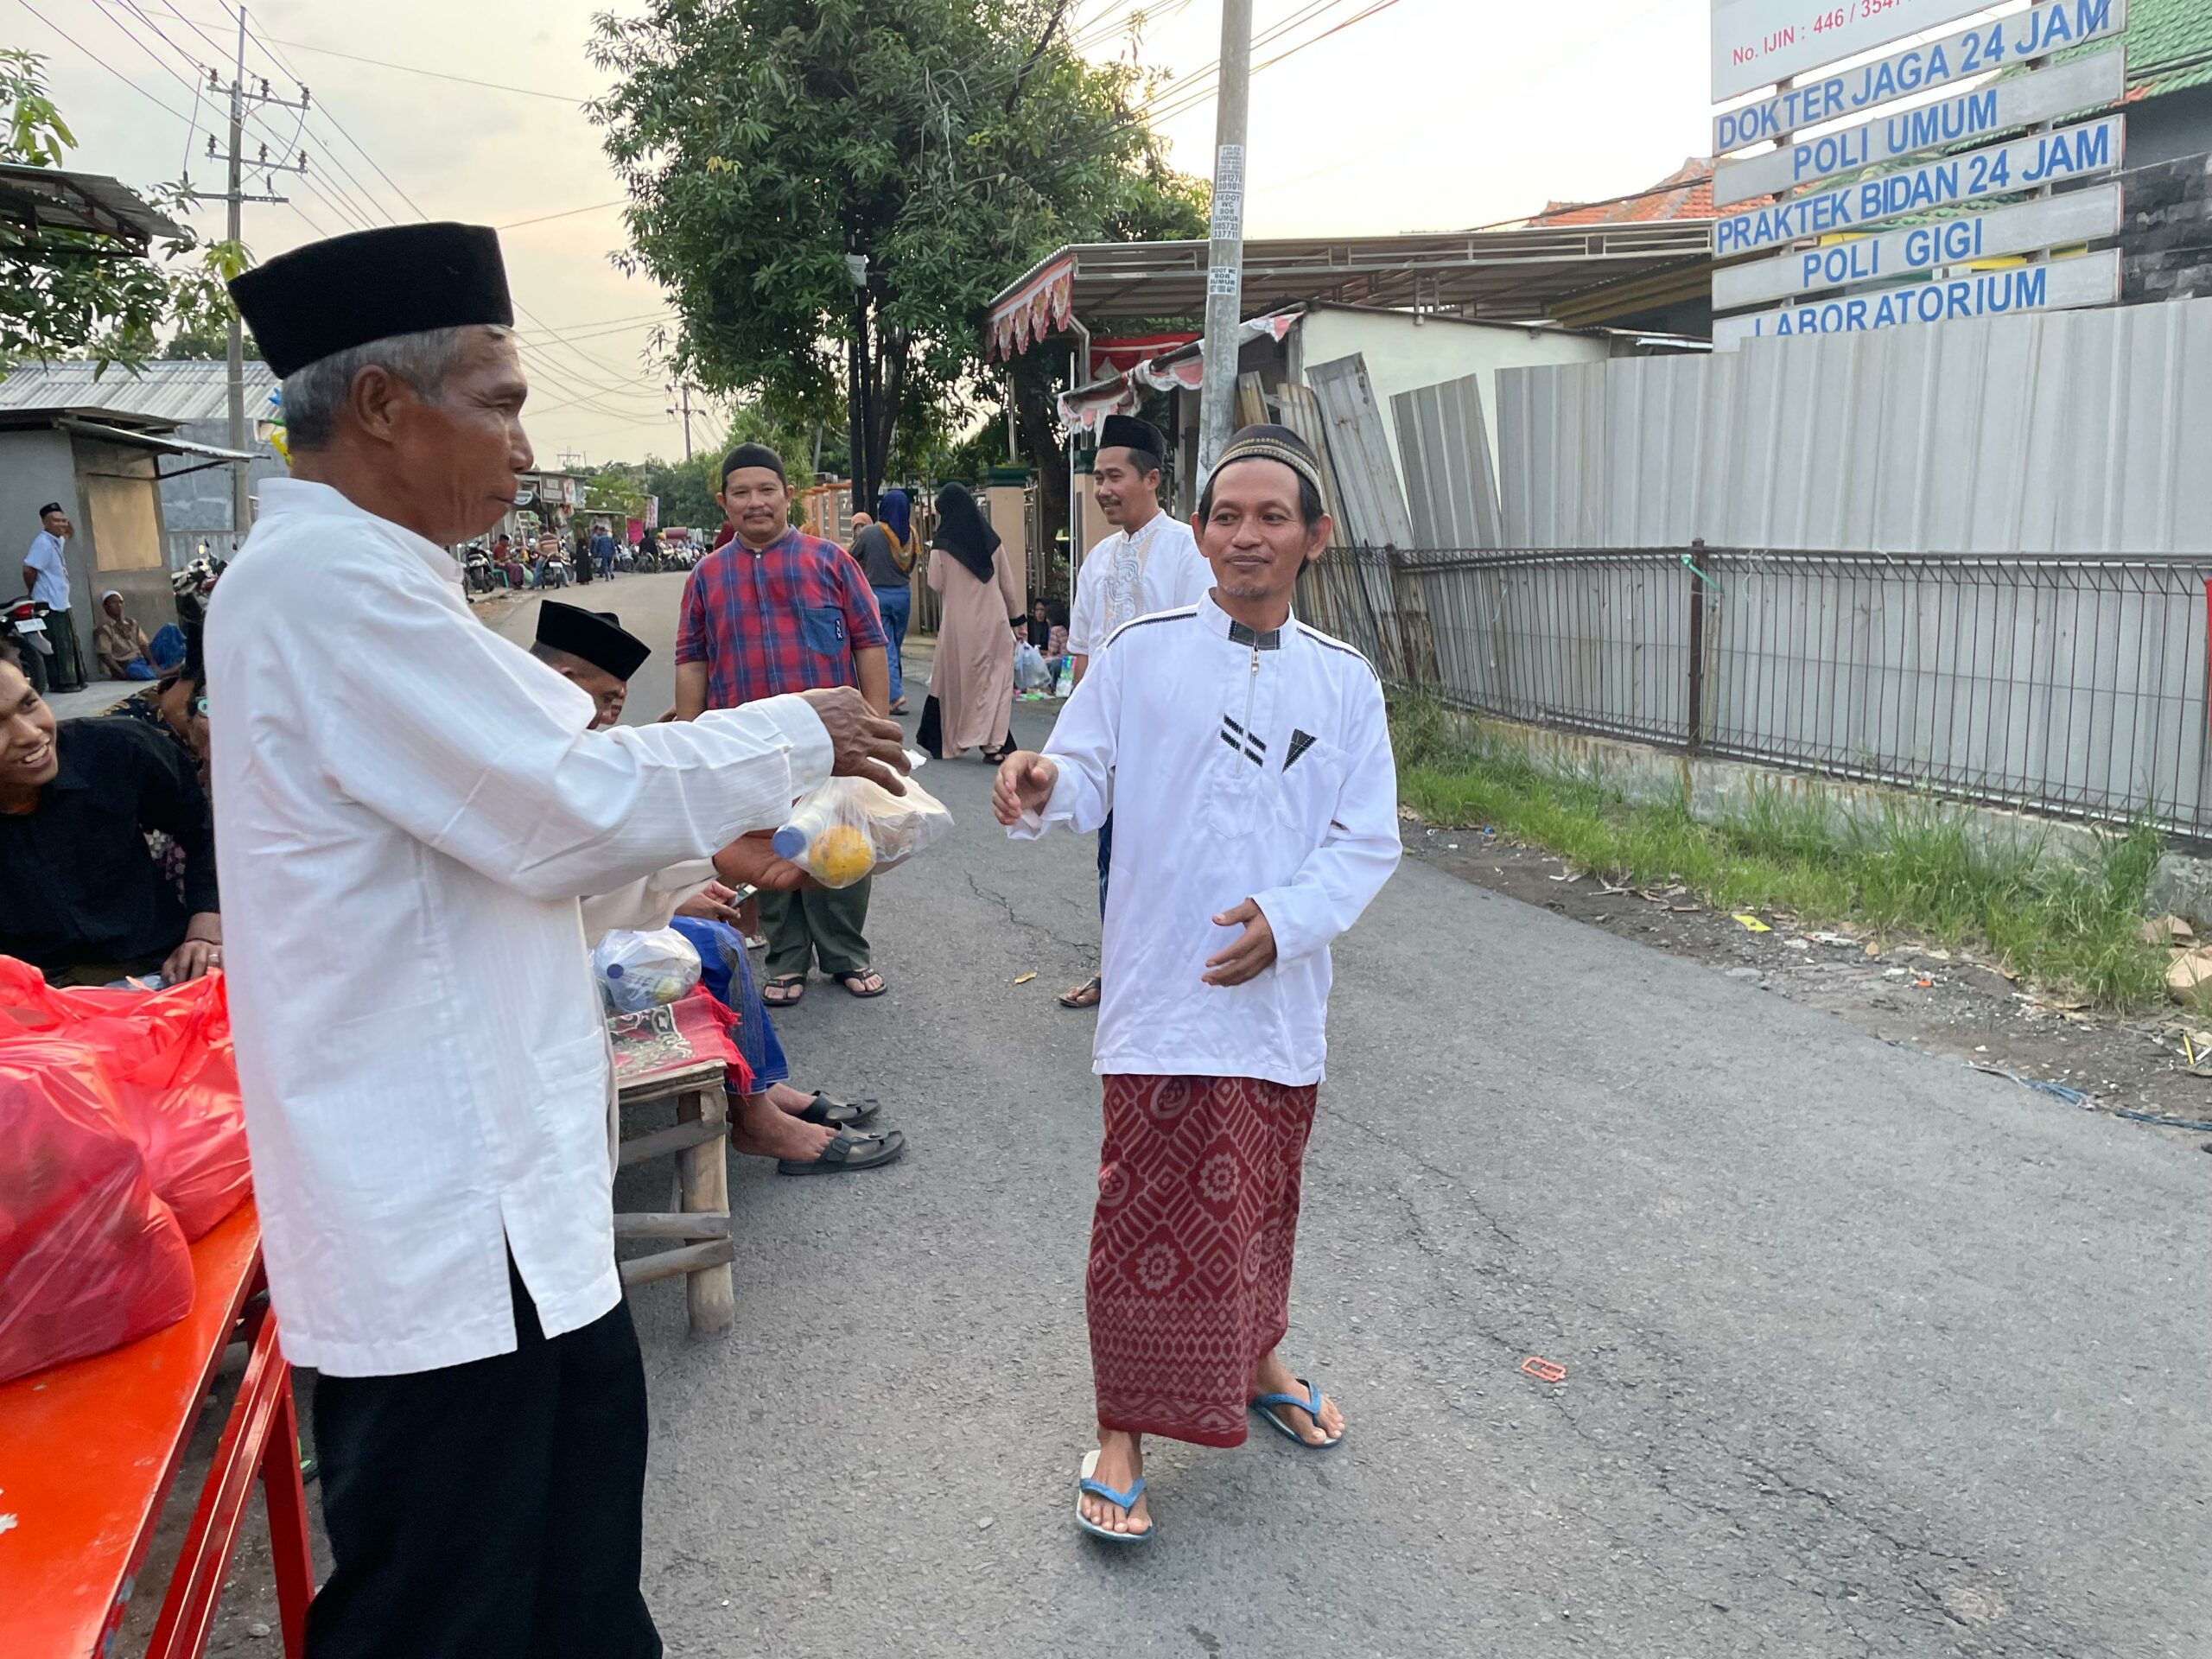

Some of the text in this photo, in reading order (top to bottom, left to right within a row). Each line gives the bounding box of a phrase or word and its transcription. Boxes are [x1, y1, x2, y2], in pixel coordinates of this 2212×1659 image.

[1719, 0, 2109, 149] DOKTER JAGA 24 JAM
[1733, 46, 1758, 66] No.
[1764, 26, 1795, 54] IJIN
[1814, 9, 1844, 34] 446
[1850, 3, 1856, 23] /
[1794, 89, 1997, 181] POLI UMUM
[1718, 124, 2108, 253] PRAKTEK BIDAN 24 JAM
[1803, 218, 1982, 289] POLI GIGI
